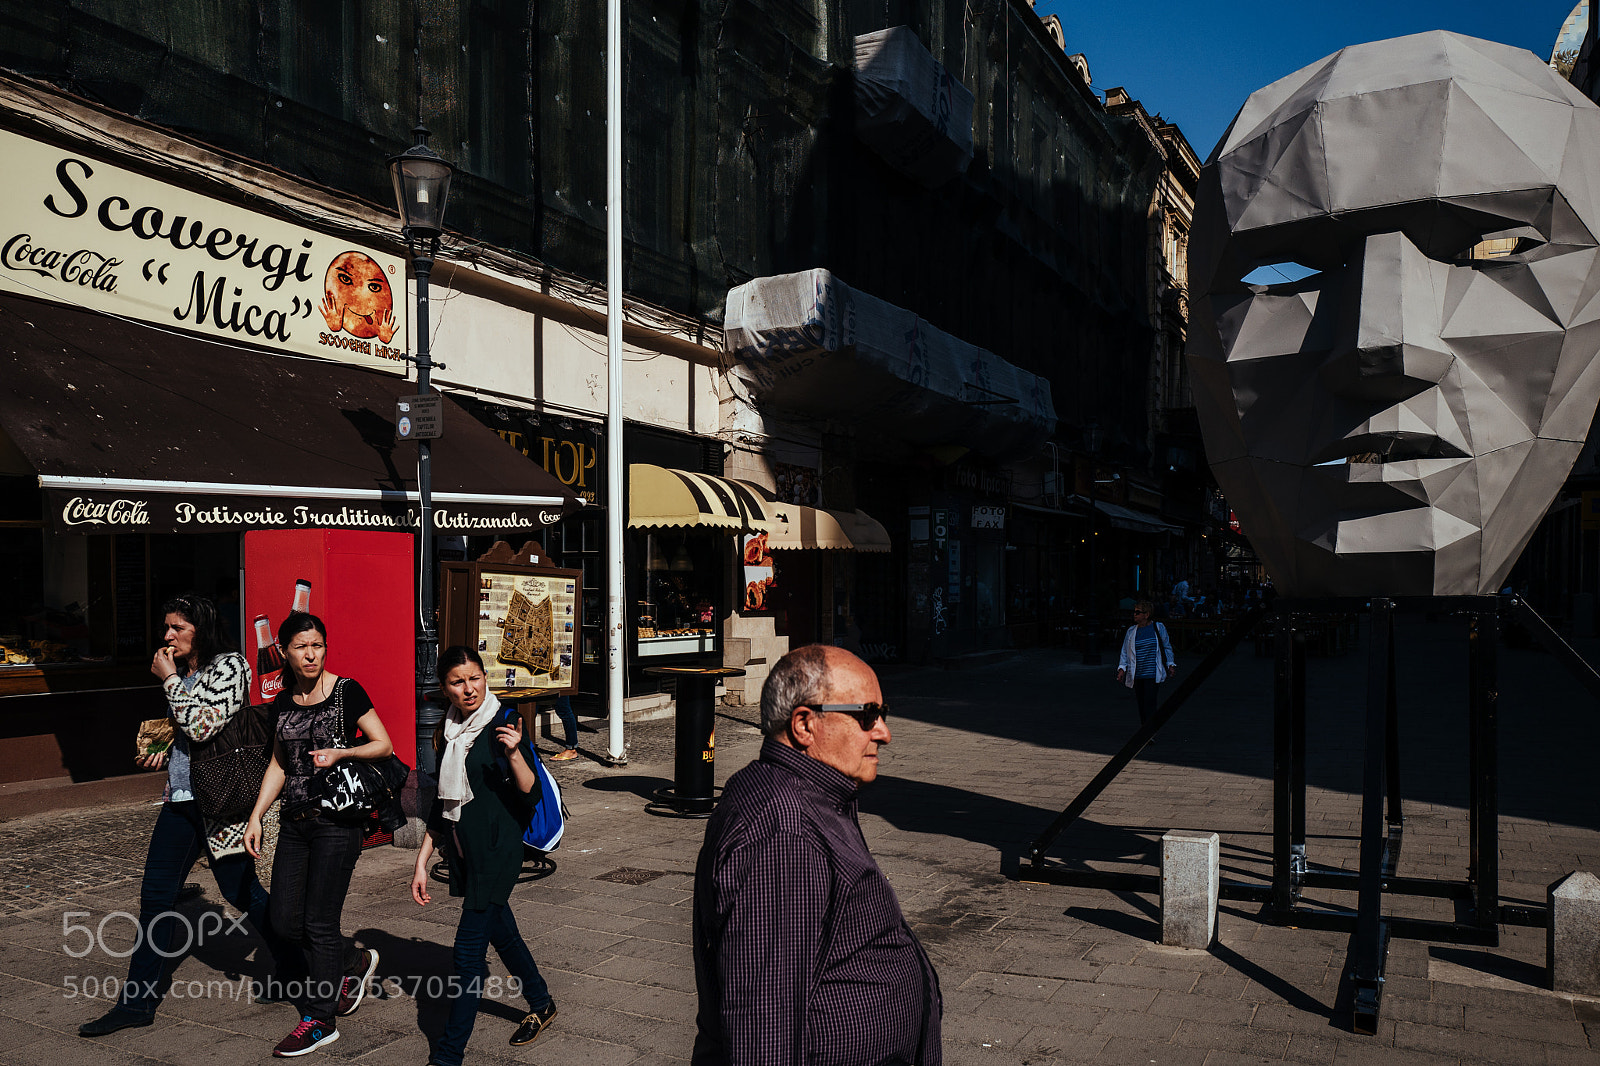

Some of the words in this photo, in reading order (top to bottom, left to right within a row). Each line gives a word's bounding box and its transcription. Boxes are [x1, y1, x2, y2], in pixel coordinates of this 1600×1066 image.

[44, 158, 313, 292] Scovergi
[1, 233, 124, 293] Coca-Cola
[540, 436, 596, 487] TOP
[62, 497, 150, 526] Coca-Cola
[175, 503, 288, 526] Patiserie
[433, 509, 533, 529] Artizanala
[973, 506, 1004, 515] FOTO
[976, 520, 999, 528] FAX
